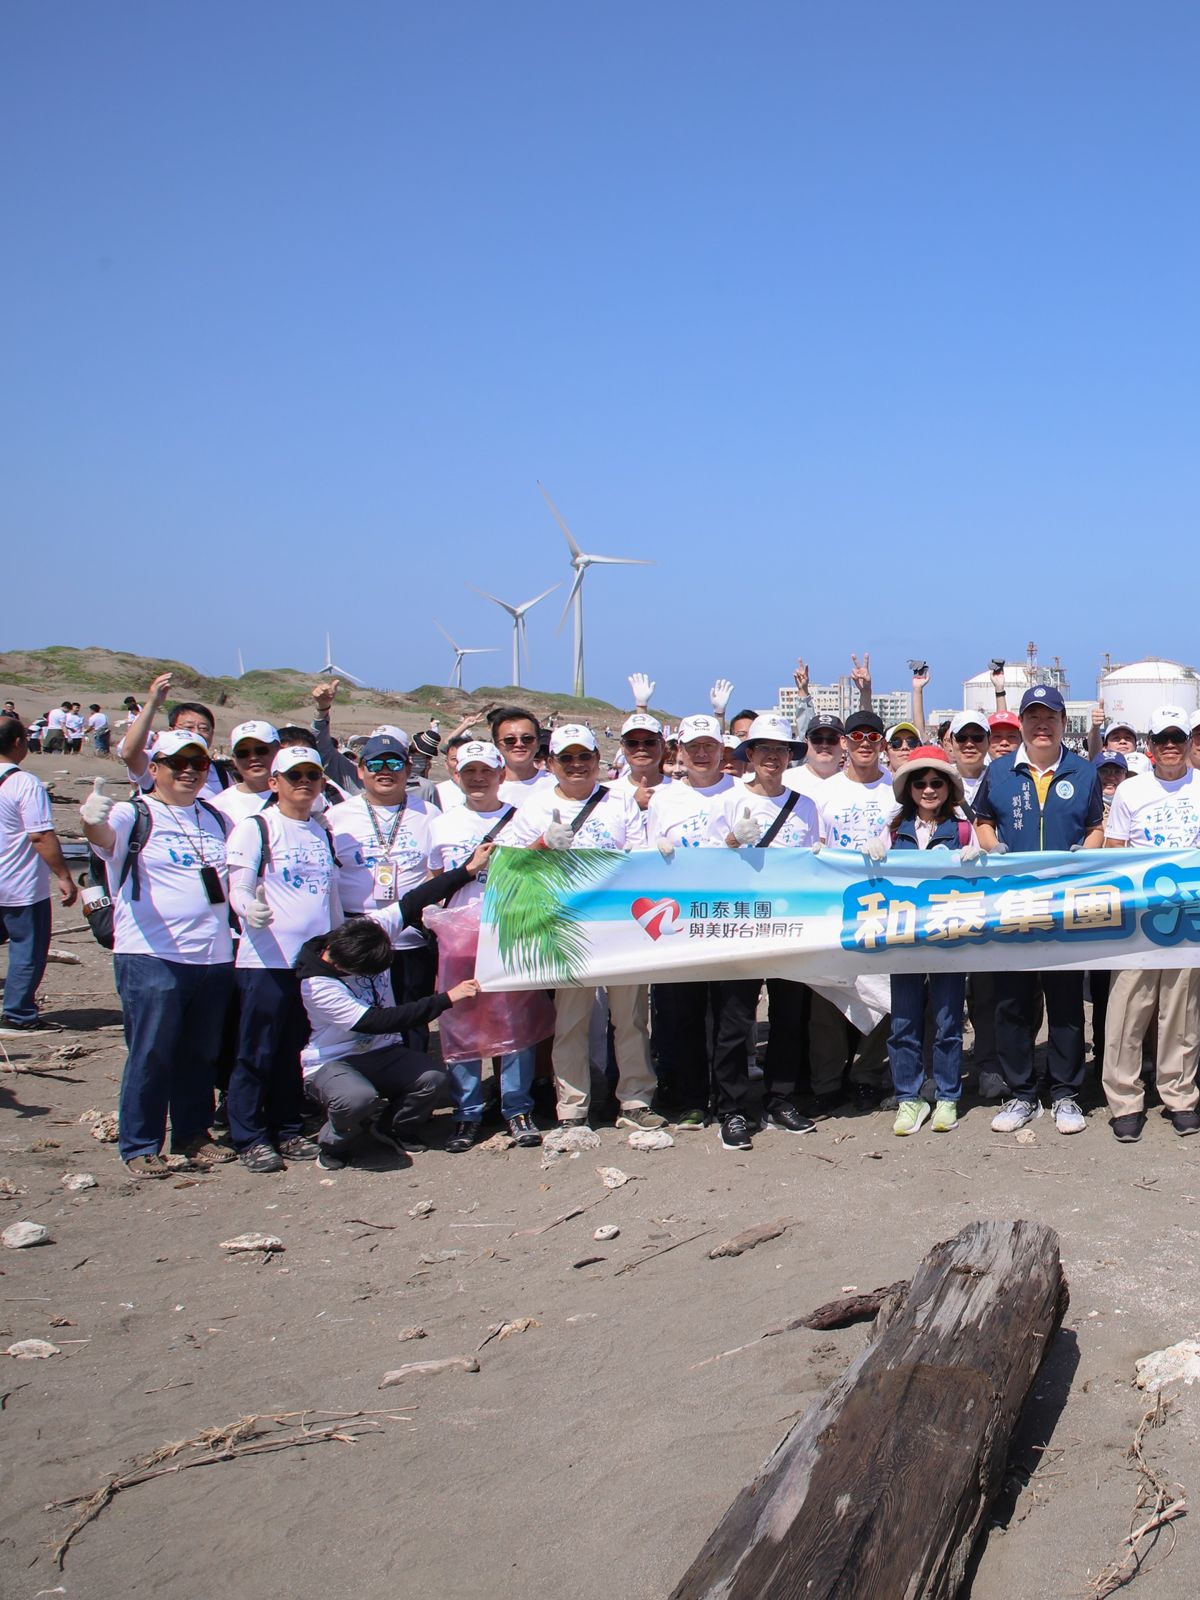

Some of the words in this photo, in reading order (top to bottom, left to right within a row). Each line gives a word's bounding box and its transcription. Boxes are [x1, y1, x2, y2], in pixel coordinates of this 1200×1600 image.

[1022, 782, 1032, 810] 副署長
[690, 901, 772, 919] 和泰集團
[854, 884, 1121, 948] 和泰集團
[689, 922, 804, 938] 與美好台灣同行
